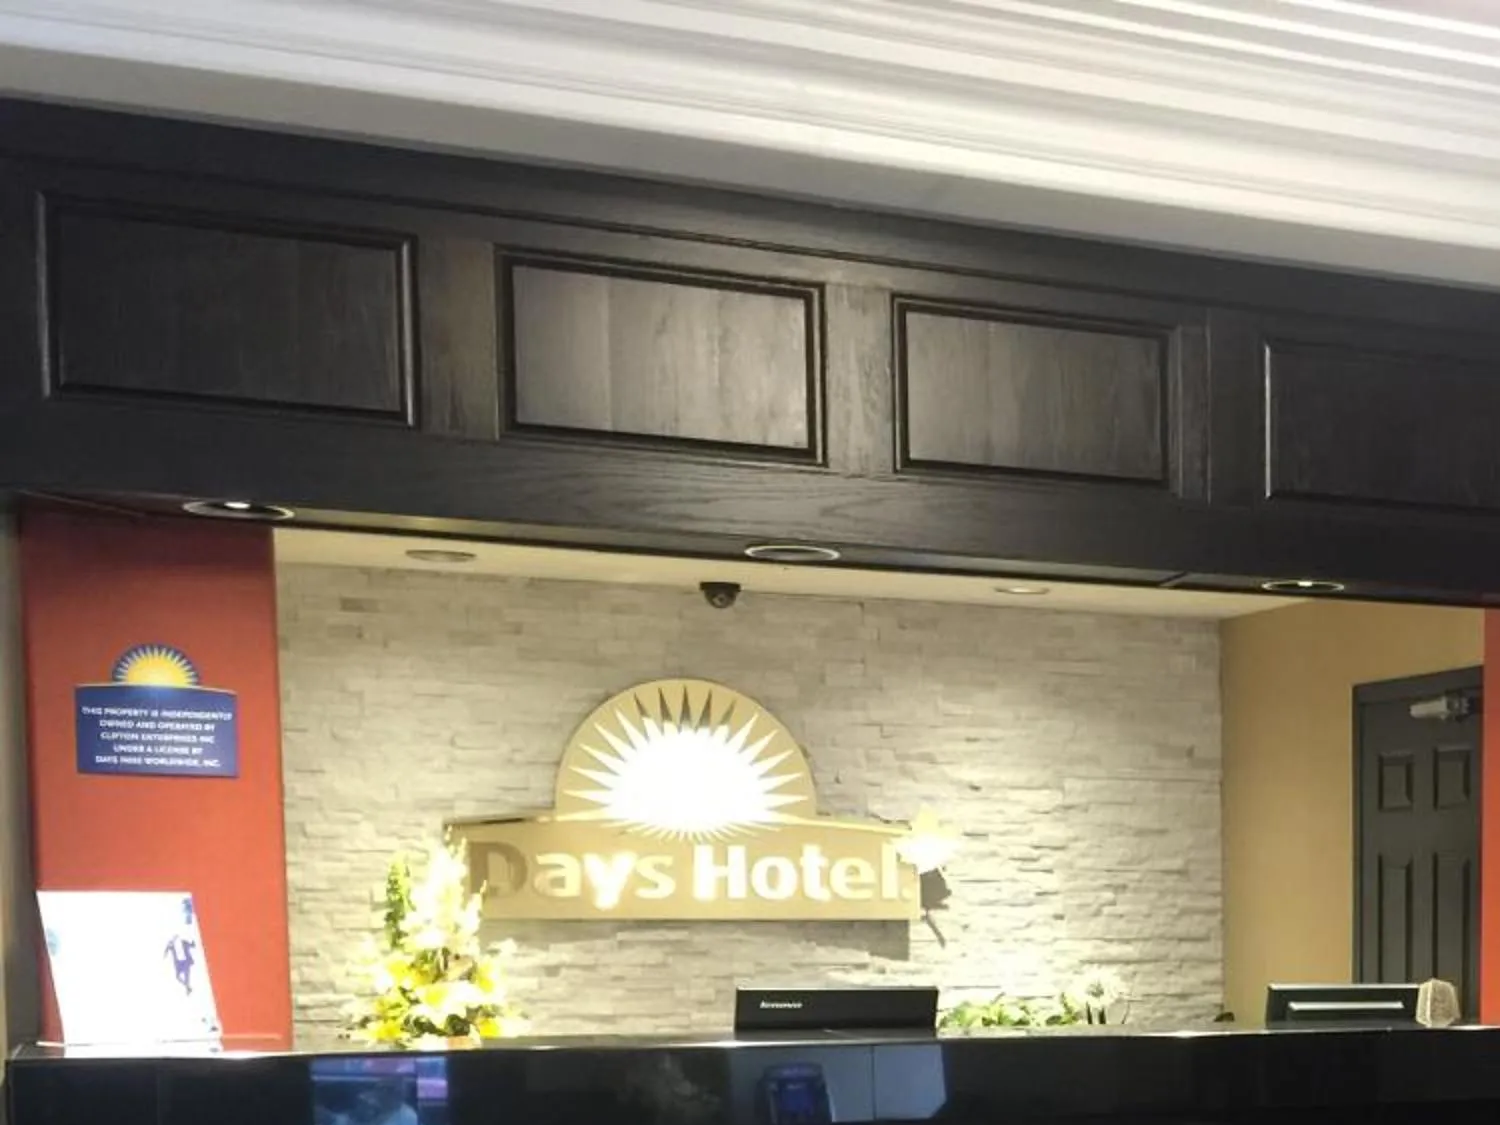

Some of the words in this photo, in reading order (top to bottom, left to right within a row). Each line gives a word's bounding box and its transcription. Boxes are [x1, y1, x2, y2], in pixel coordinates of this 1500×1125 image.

[104, 707, 148, 717] PROPERTY
[99, 719, 134, 728] OWNED
[136, 720, 156, 729] AND
[158, 721, 202, 731] OPERATED
[204, 723, 215, 732] BY
[113, 744, 145, 753] UNDER
[95, 755, 118, 765] DAYS
[467, 841, 677, 910] Days
